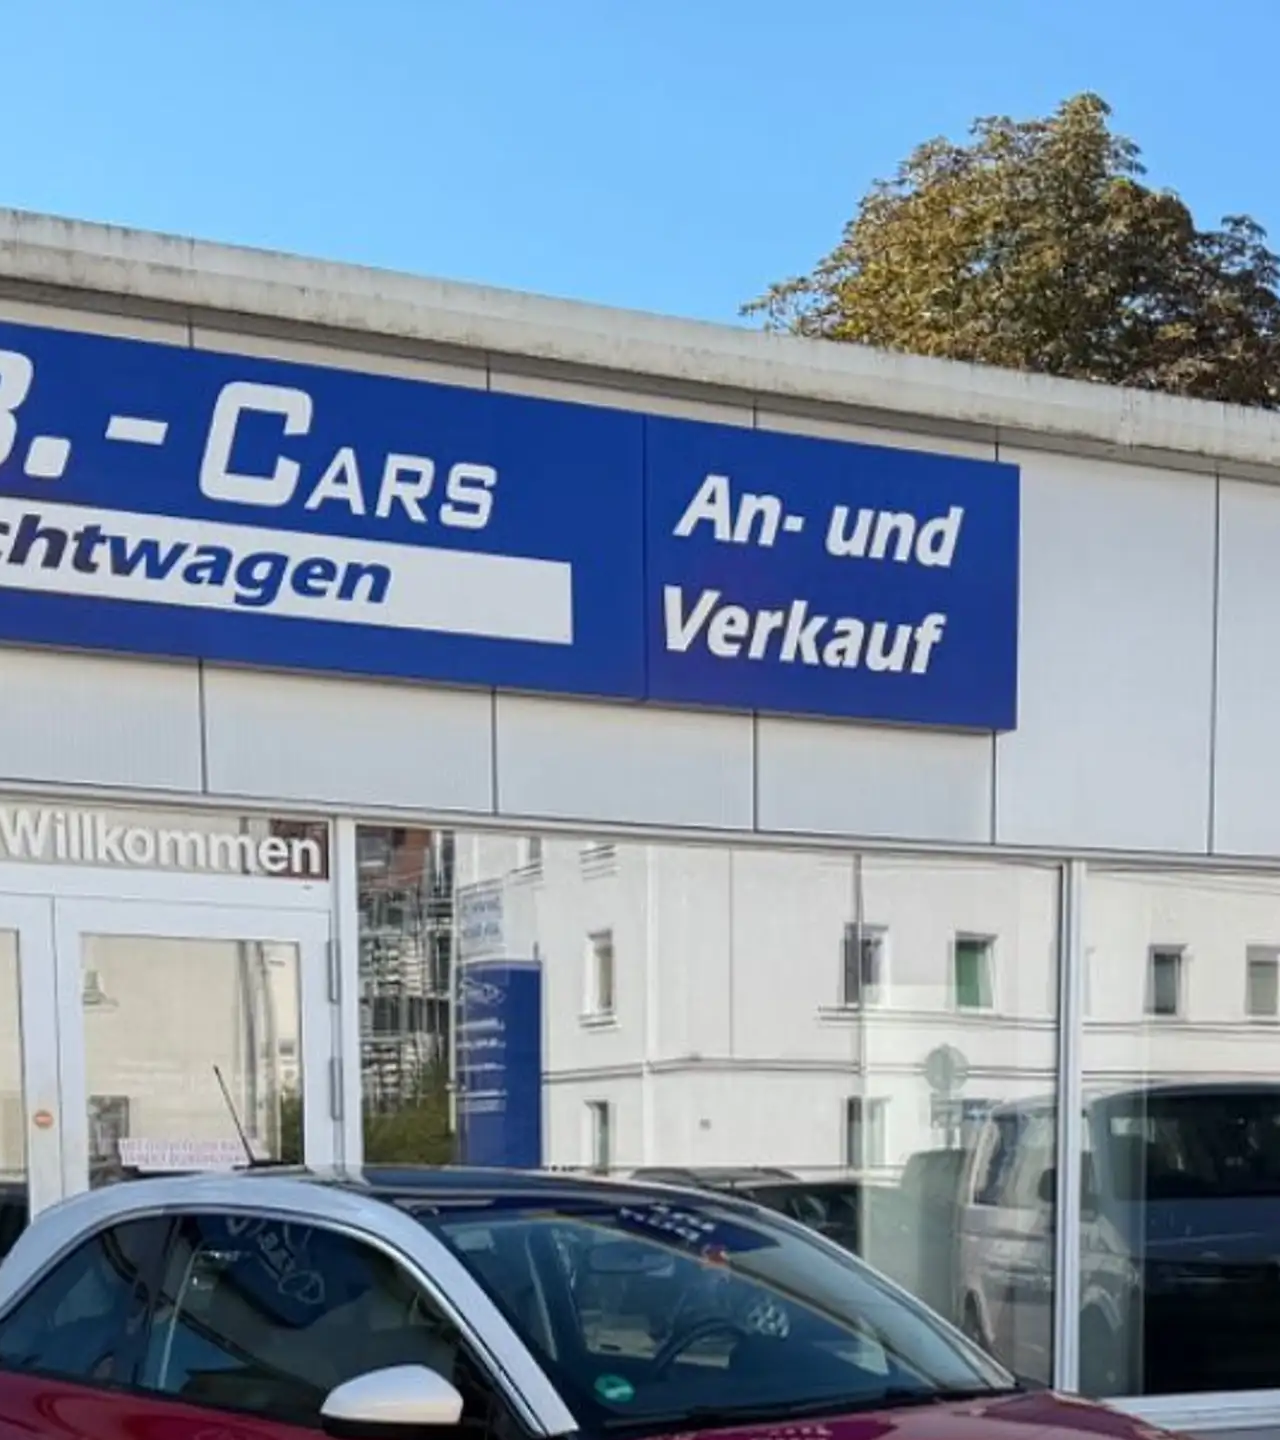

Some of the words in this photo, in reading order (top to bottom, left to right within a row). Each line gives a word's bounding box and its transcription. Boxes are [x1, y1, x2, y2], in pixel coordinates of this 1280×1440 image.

[674, 475, 803, 547] An-
[826, 507, 964, 568] und
[663, 585, 947, 674] Verkauf
